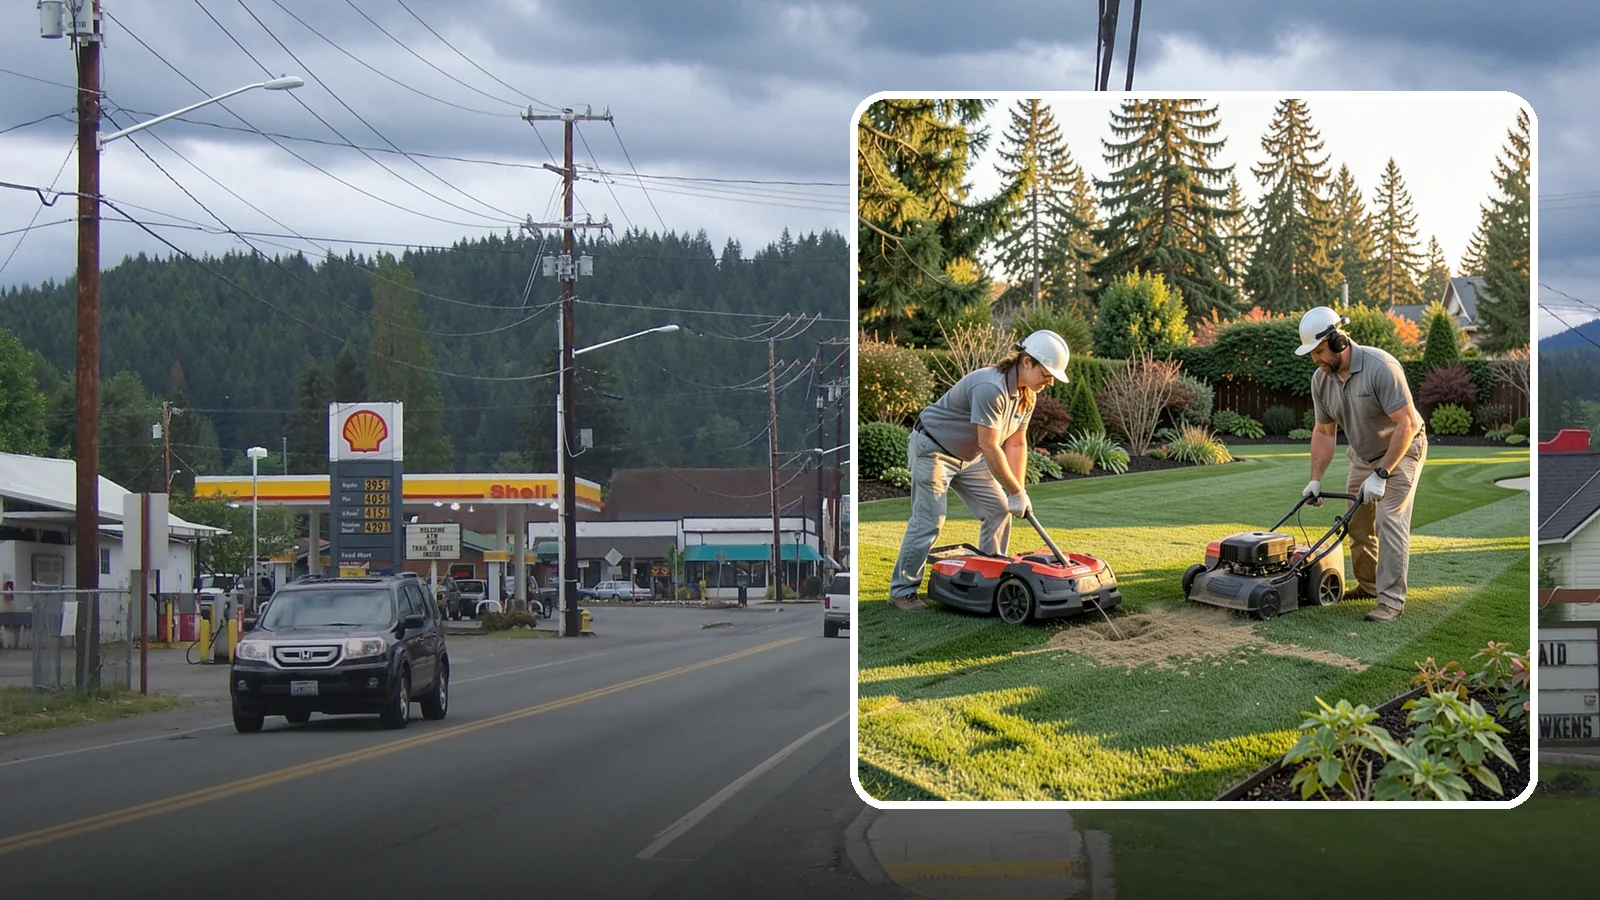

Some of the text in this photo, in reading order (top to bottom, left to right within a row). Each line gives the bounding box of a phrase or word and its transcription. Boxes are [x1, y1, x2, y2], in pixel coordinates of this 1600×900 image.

[366, 480, 383, 490] 395
[490, 484, 547, 499] Shell
[366, 494, 383, 504] 405
[366, 508, 383, 518] 415
[366, 522, 384, 532] 429
[1539, 643, 1566, 665] AID
